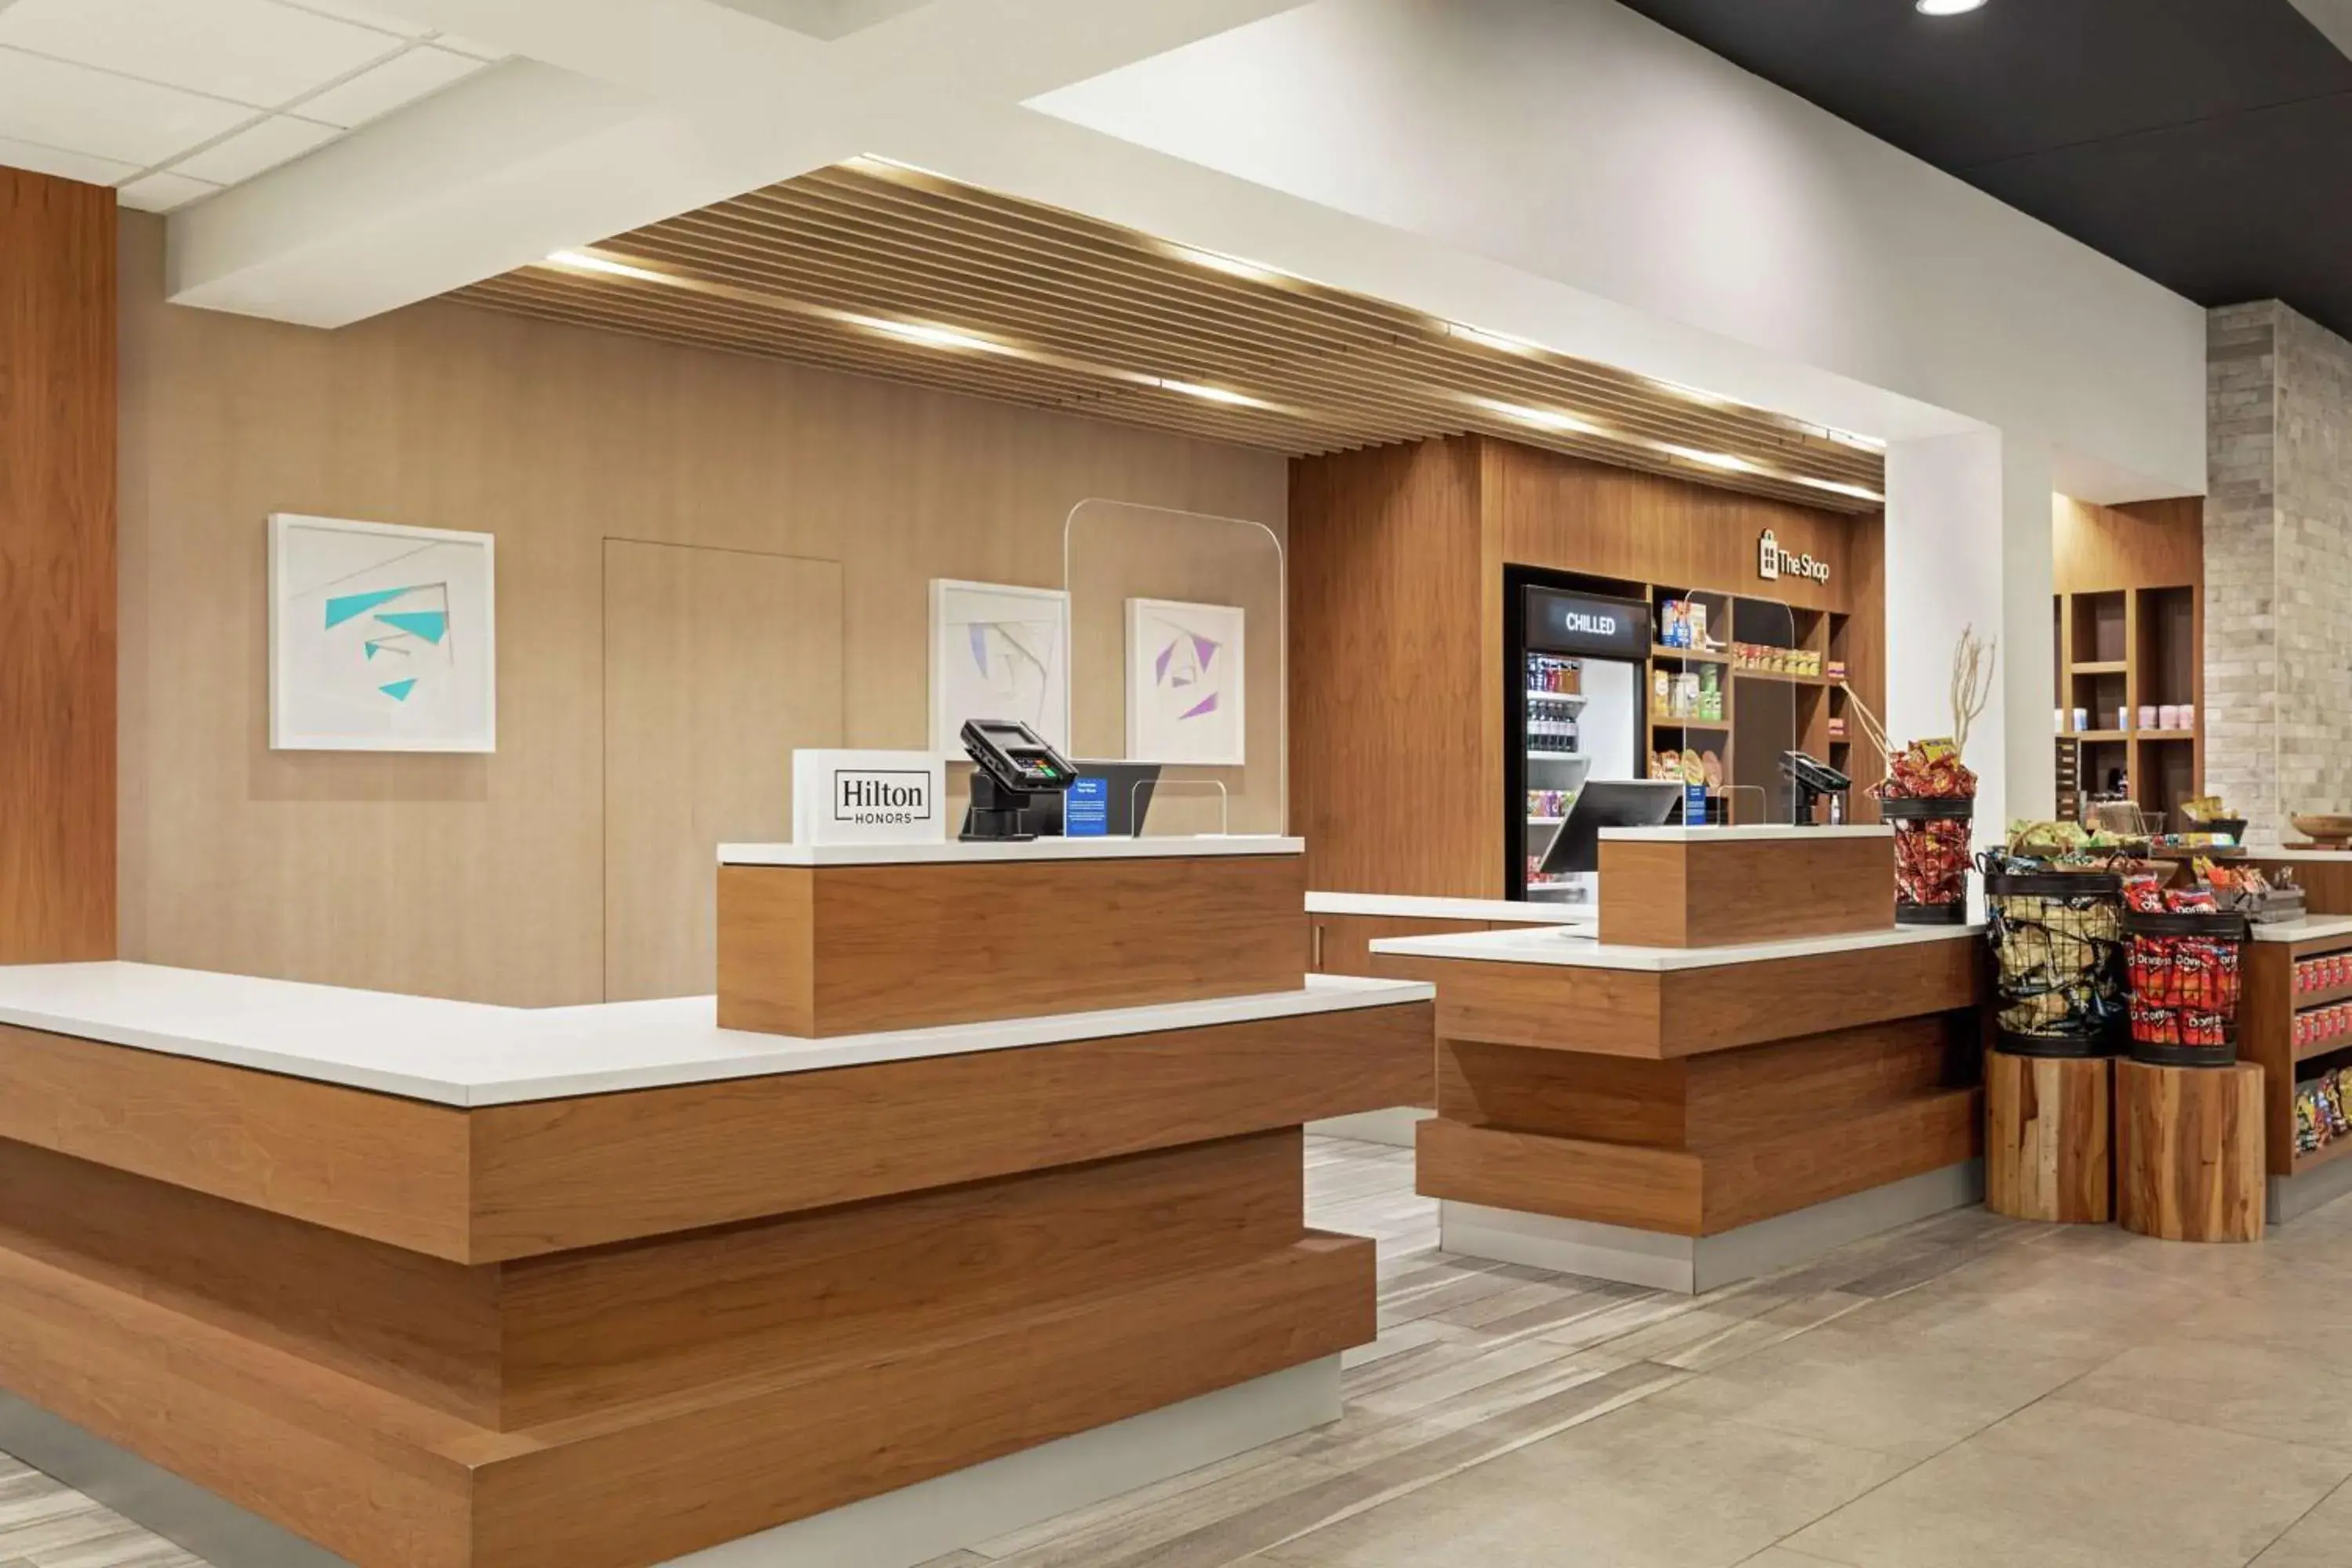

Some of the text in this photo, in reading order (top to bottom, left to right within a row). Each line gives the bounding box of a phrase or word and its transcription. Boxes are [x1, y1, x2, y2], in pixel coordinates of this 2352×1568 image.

[1778, 549, 1829, 583] The Shop
[1566, 612, 1616, 636] CHILLED
[843, 779, 923, 807] Hilton
[855, 812, 912, 824] HONORS
